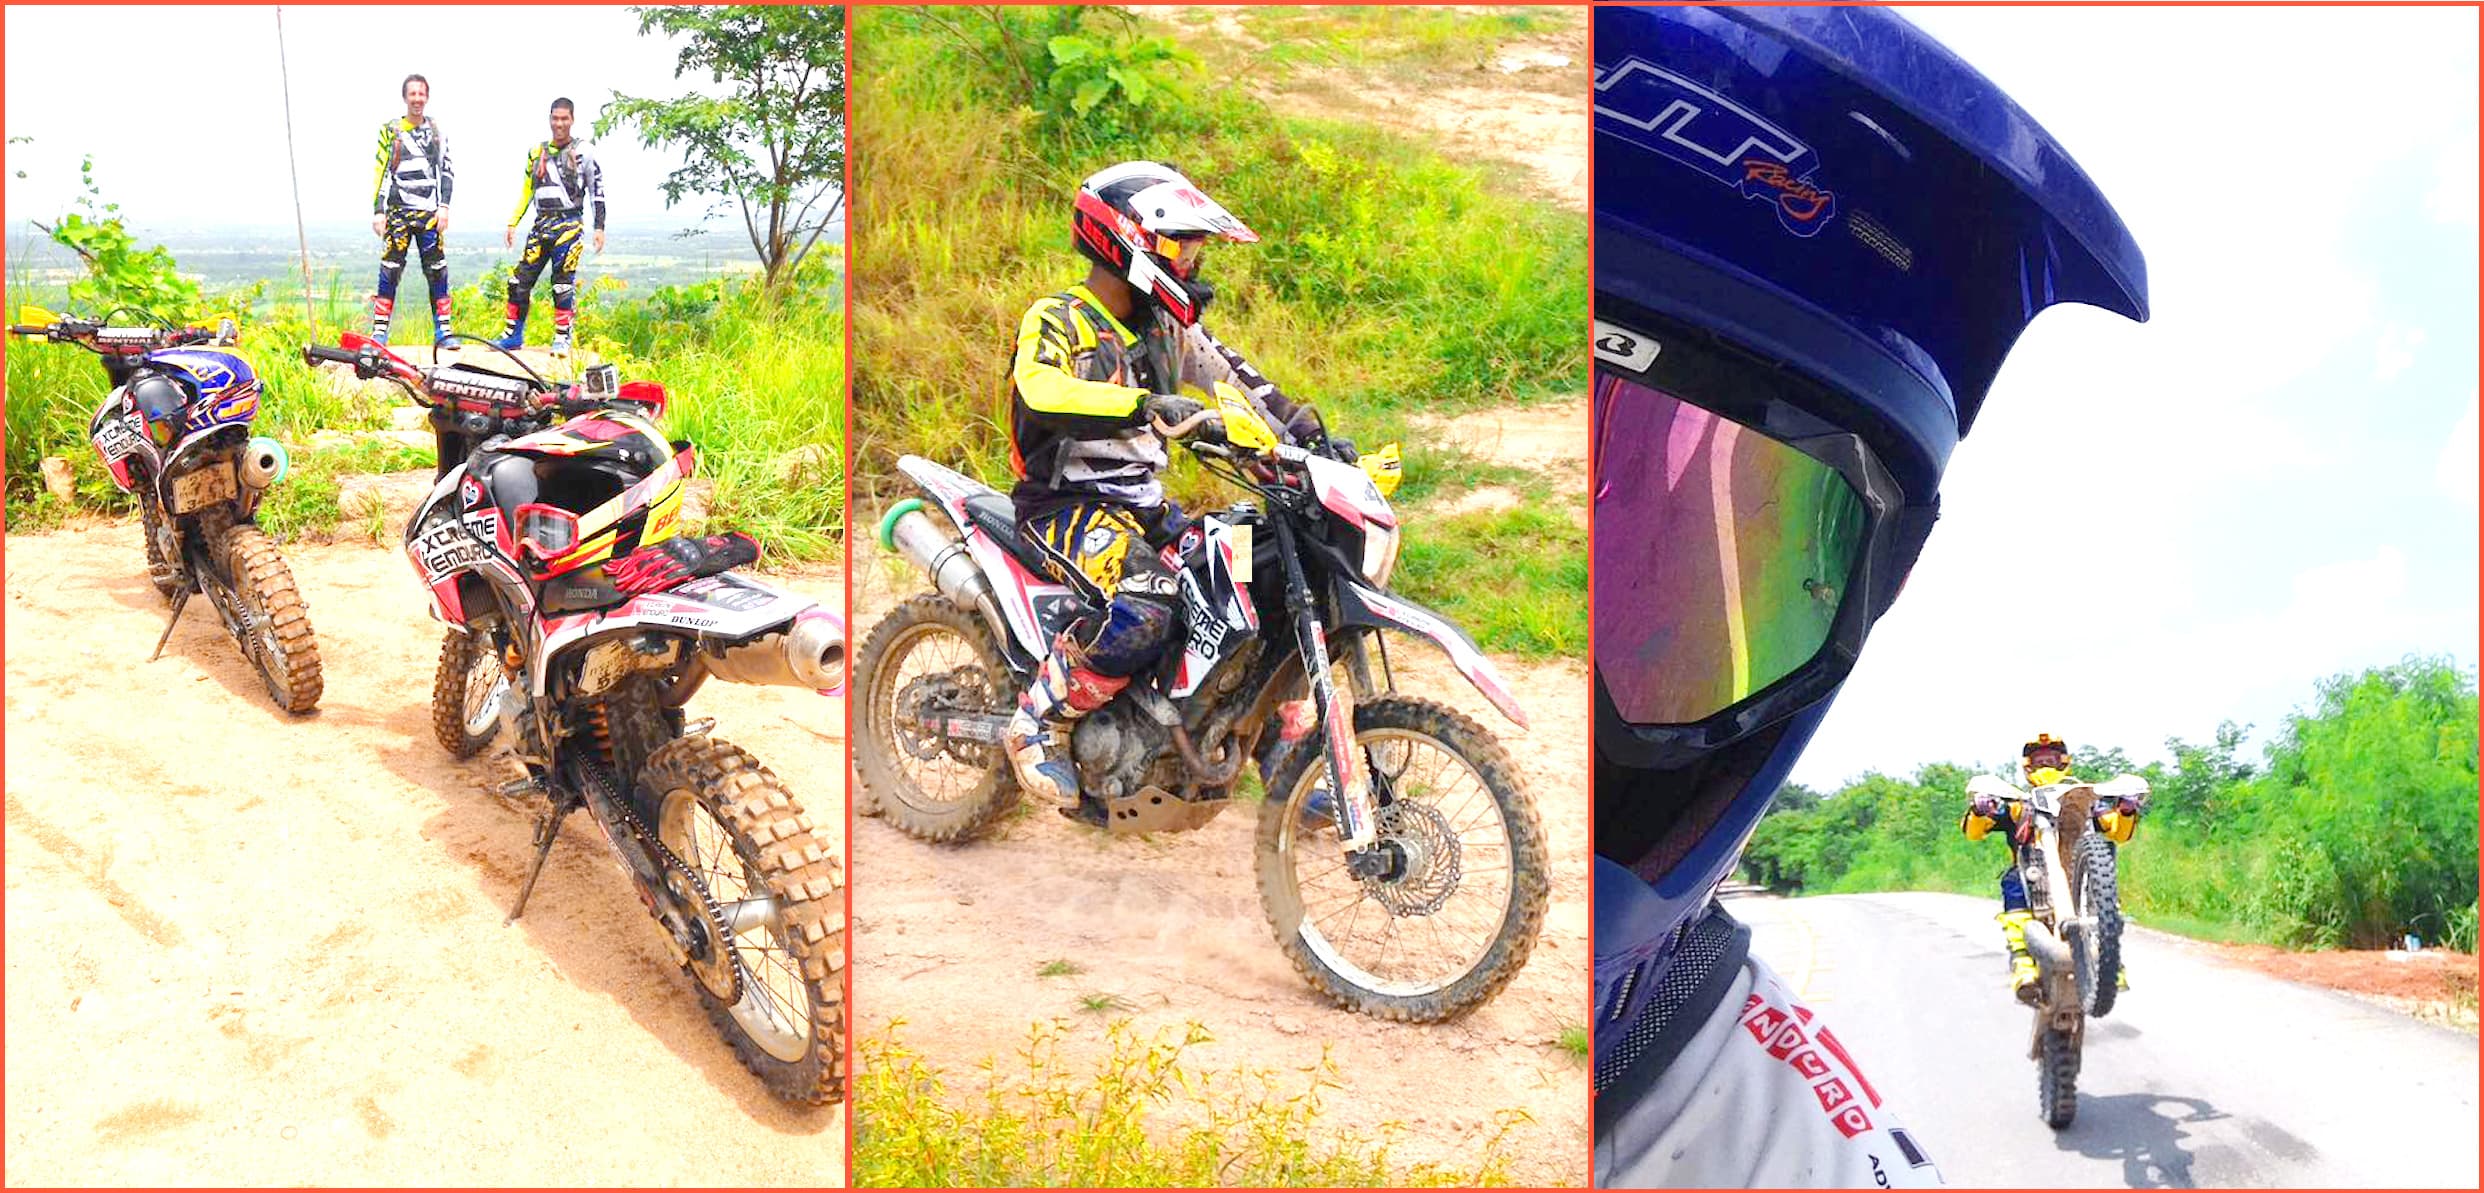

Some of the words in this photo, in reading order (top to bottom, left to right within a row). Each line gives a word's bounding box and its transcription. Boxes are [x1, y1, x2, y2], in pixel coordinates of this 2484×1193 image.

[1743, 157, 1832, 222] Racing
[1083, 215, 1124, 269] BELL
[431, 380, 519, 403] RENTHAL
[565, 587, 598, 599] HONDA
[670, 615, 719, 627] DUNLOP
[1867, 1153, 1893, 1189] AD
